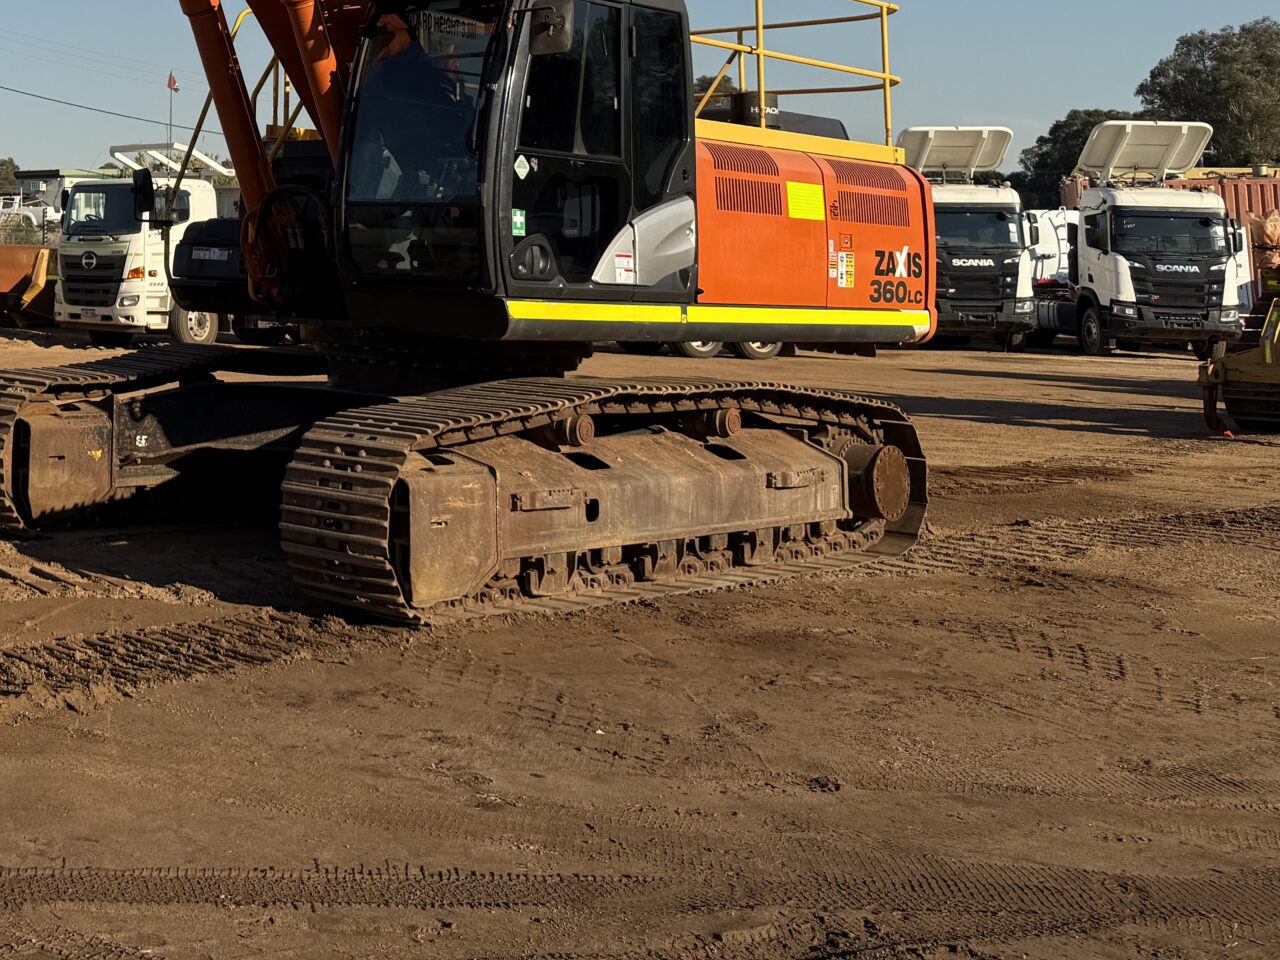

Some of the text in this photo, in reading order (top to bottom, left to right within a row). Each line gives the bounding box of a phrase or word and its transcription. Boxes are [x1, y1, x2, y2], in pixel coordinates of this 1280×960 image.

[874, 245, 923, 279] ZAXIS
[951, 258, 995, 267] SCANIA
[1155, 263, 1201, 273] SCANIA
